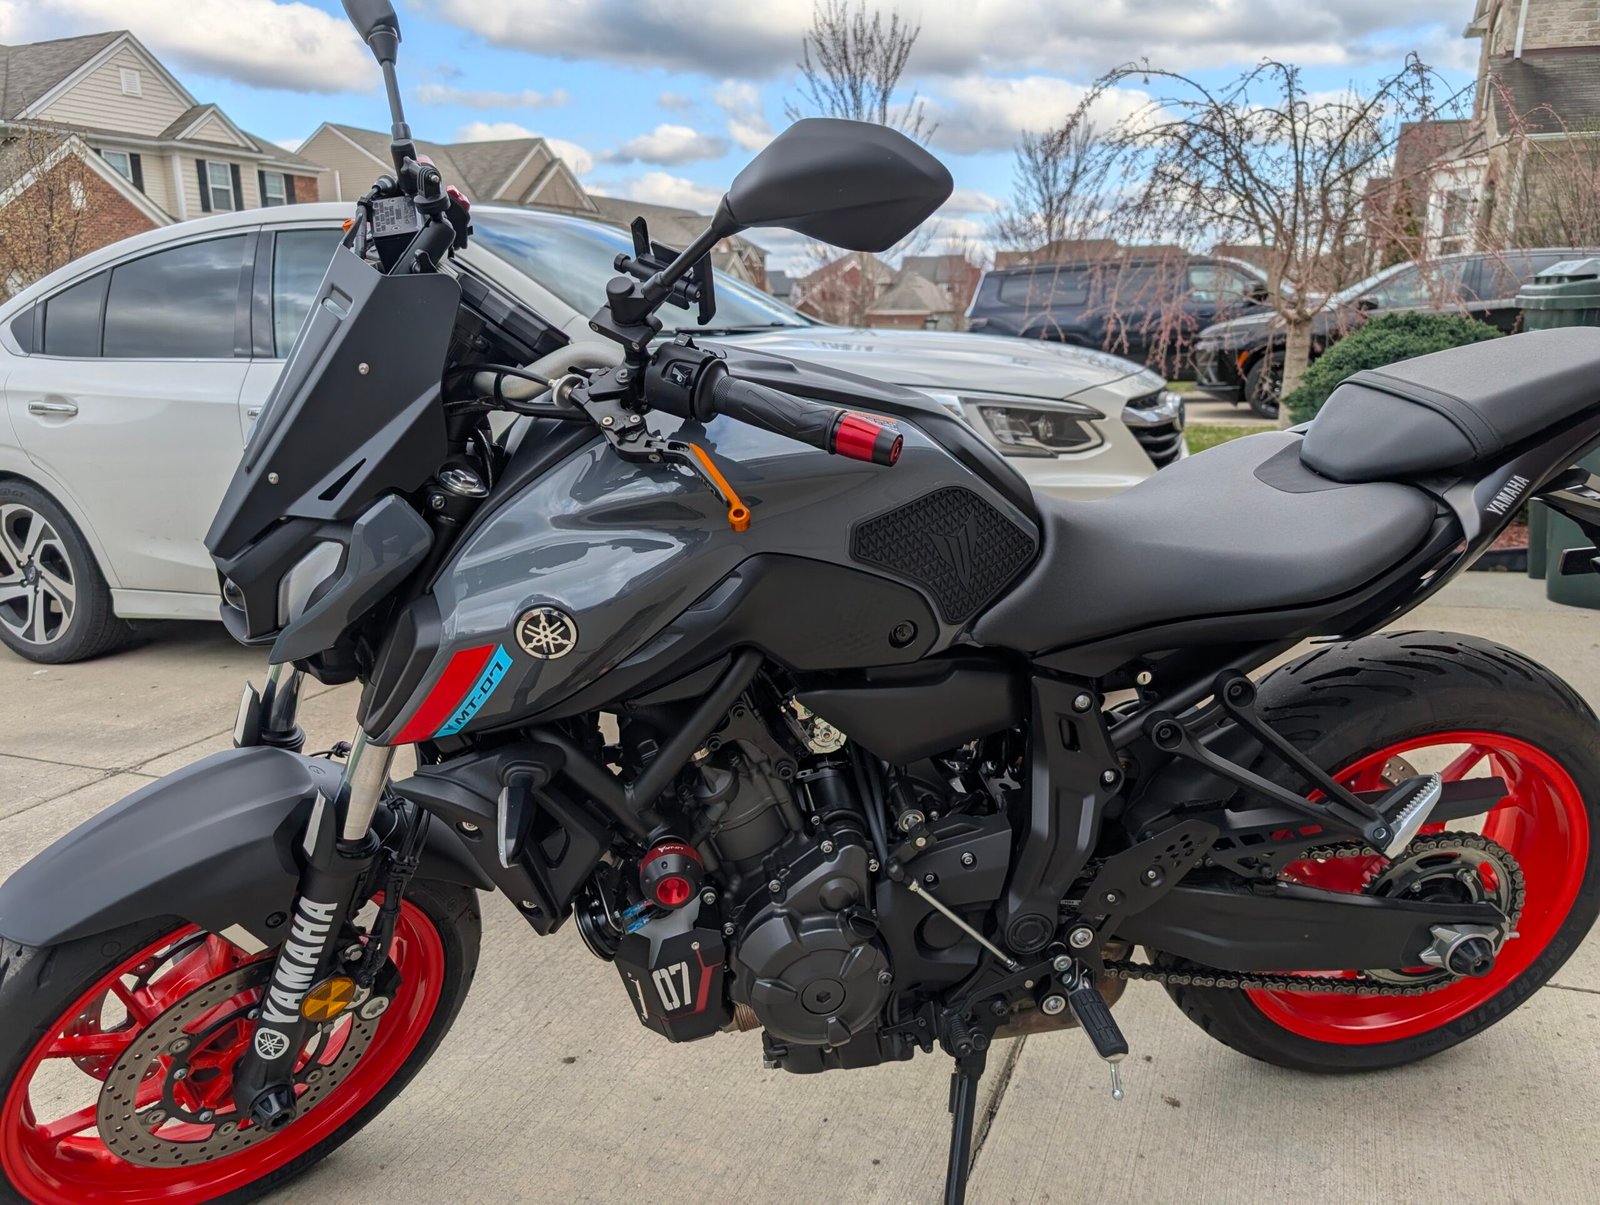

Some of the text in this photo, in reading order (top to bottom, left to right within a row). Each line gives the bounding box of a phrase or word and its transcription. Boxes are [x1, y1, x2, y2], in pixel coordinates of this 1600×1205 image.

[1486, 475, 1530, 516] YAMAHA
[455, 660, 504, 726] MT-07
[262, 896, 338, 1023] YAMAHA
[652, 961, 692, 1012] 07
[1460, 937, 1568, 1031] MICHELIN
